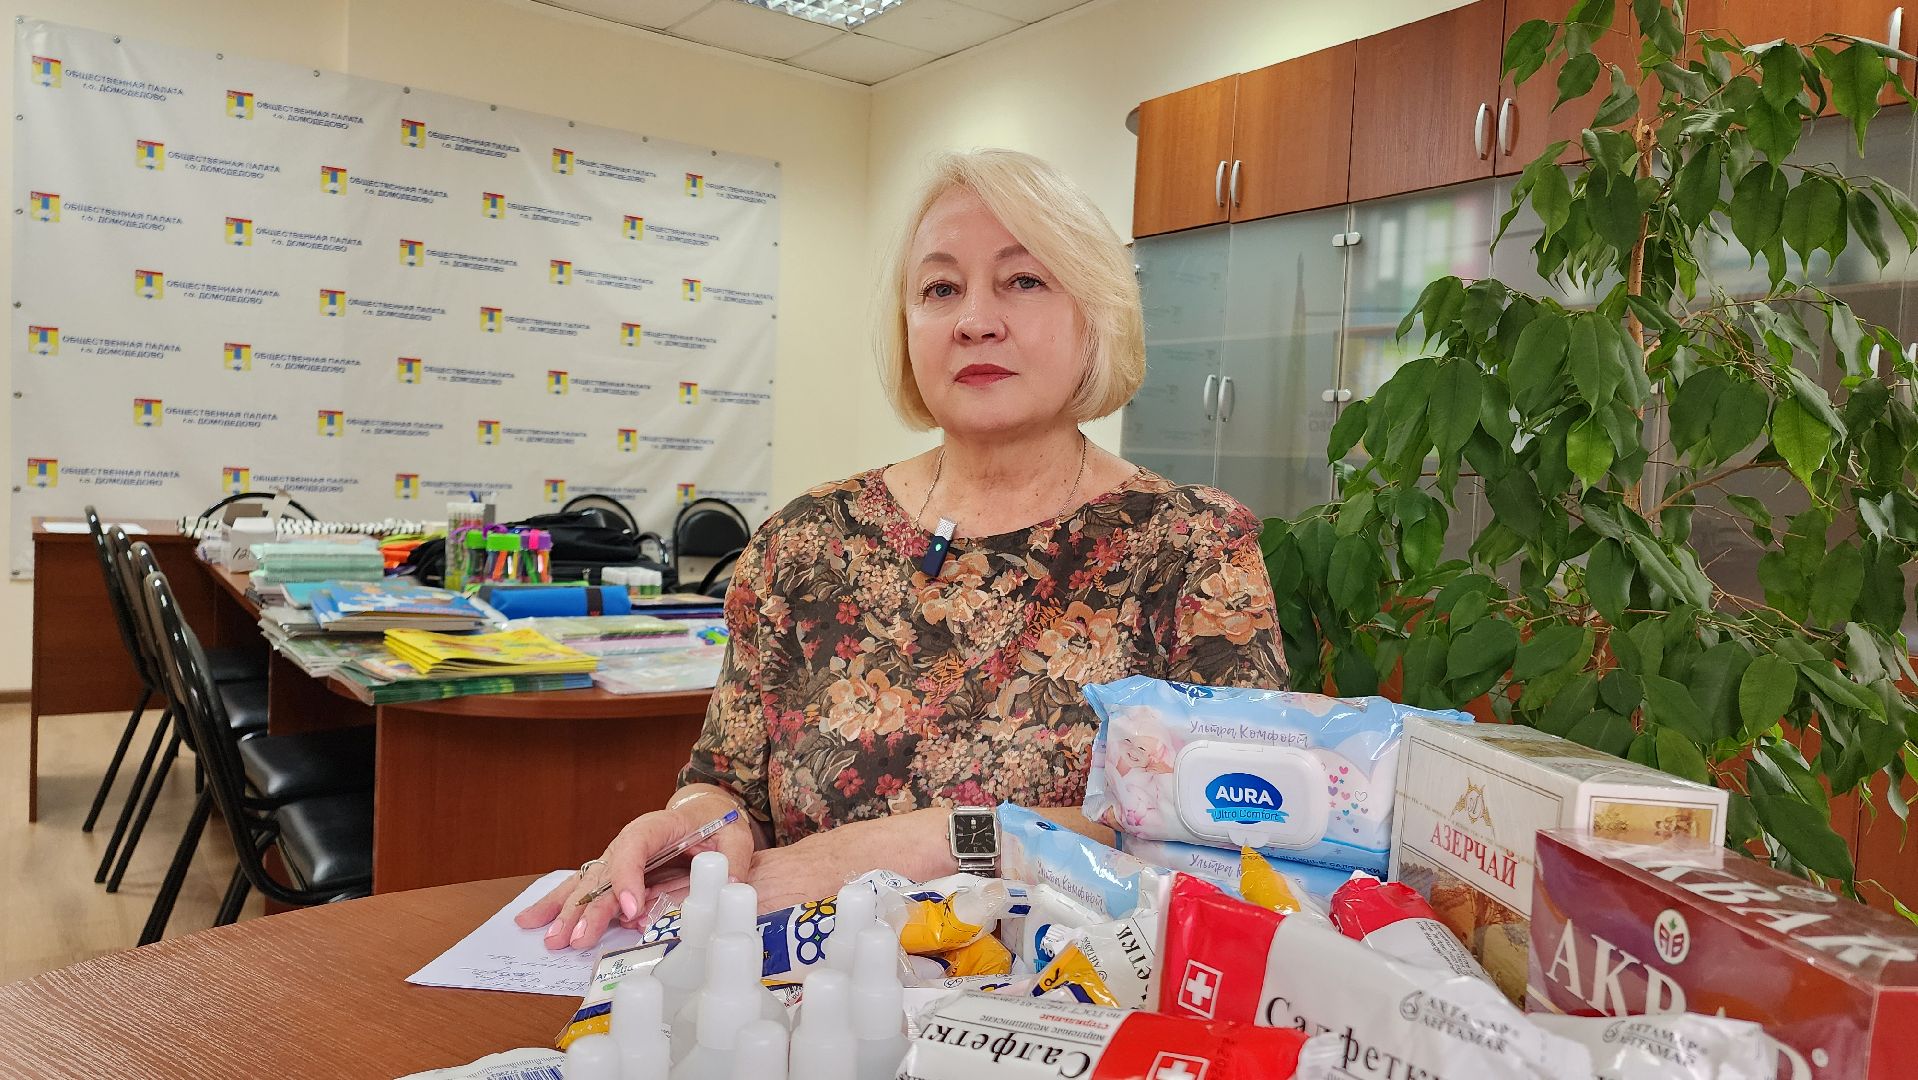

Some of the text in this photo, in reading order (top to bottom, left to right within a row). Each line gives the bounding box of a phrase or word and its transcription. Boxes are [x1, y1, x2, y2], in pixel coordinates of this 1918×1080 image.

[65, 69, 184, 96] ОБЩЕСТВЕННАЯ ПАЛАТА
[99, 84, 167, 102] ДОМОДЕДОВО
[257, 101, 364, 125] ОБЩЕСТВЕННАЯ ПАЛАТА
[287, 114, 351, 131] ДОМОДЕДОВО
[168, 151, 280, 175] ОБЩЕСТВЕННАЯ ПАЛАТА
[200, 164, 267, 182] ДОМОДЕДОВО
[64, 202, 184, 226] ОБЩЕСТВЕННАЯ ПАЛАТА
[98, 216, 165, 232] ДОМОДЕДОВО
[256, 228, 362, 247] ОБЩЕСТВЕННАЯ ПАЛАТА
[286, 240, 347, 254] ДОМОДЕДОВО
[166, 280, 280, 299] ОБЩЕСТВЕННАЯ ПАЛАТА
[198, 292, 263, 306] ДОМОДЕДОВО
[62, 336, 181, 353] ОБЩЕСТВЕННАЯ ПАЛАТА
[96, 347, 164, 360] ДОМОДЕДОВО
[254, 352, 361, 367] ОБЩЕСТВЕННАЯ ПАЛАТА
[284, 362, 346, 374] ДОМОДЕДОВО
[165, 408, 278, 421] ОБЩЕСТВЕННАЯ ПАЛАТА
[198, 418, 263, 428] ДОМОДЕДОВО
[1190, 720, 1308, 748] Ультра Комфорт
[1216, 785, 1274, 806] AURA
[1214, 809, 1279, 821] Ultra Comfort
[1430, 821, 1518, 889] АЗЕРЧАЙ
[1190, 853, 1234, 878] Ультра
